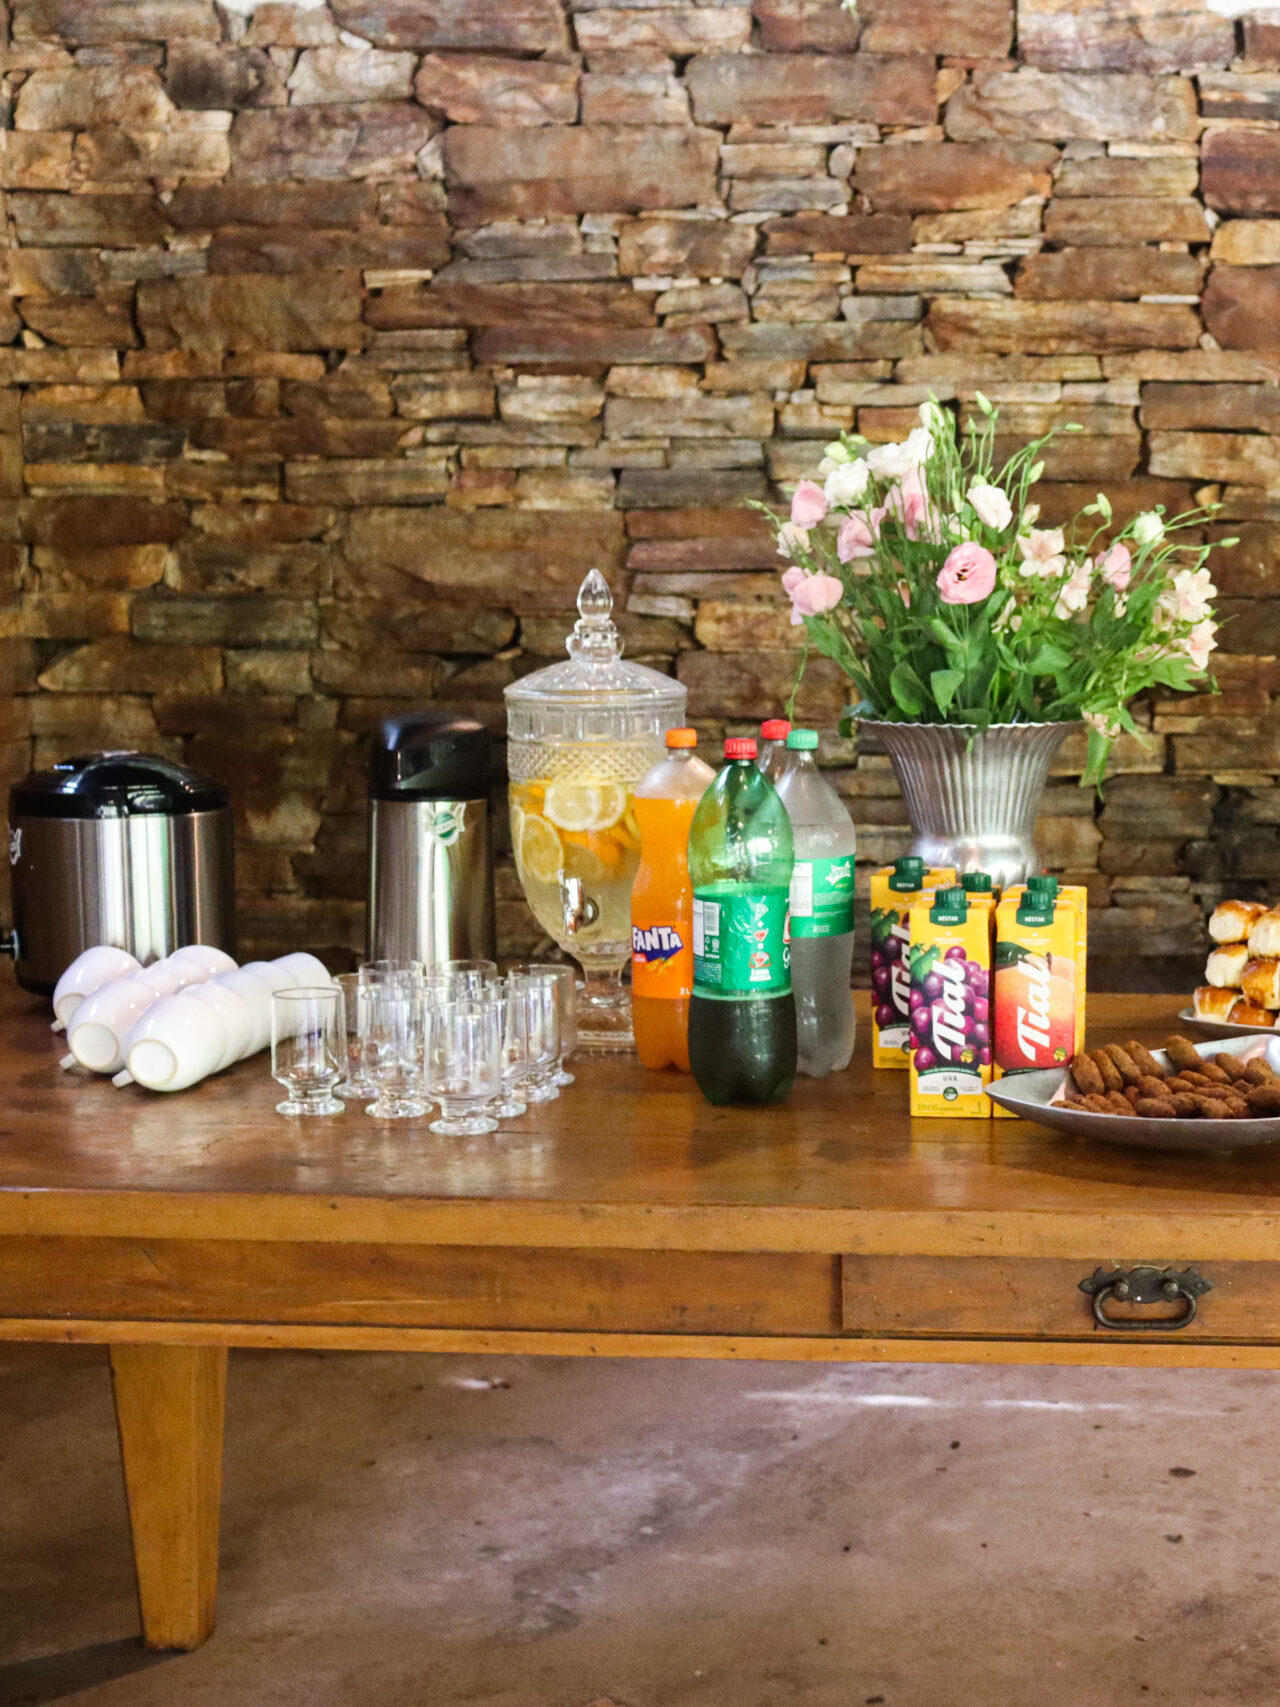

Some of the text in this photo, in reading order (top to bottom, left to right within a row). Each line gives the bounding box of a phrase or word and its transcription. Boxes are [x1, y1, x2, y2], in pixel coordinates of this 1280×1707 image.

[631, 926, 684, 952] FANTA
[932, 952, 967, 1061] Tial
[1017, 953, 1051, 1062] Tial
[942, 1074, 959, 1082] UVA
